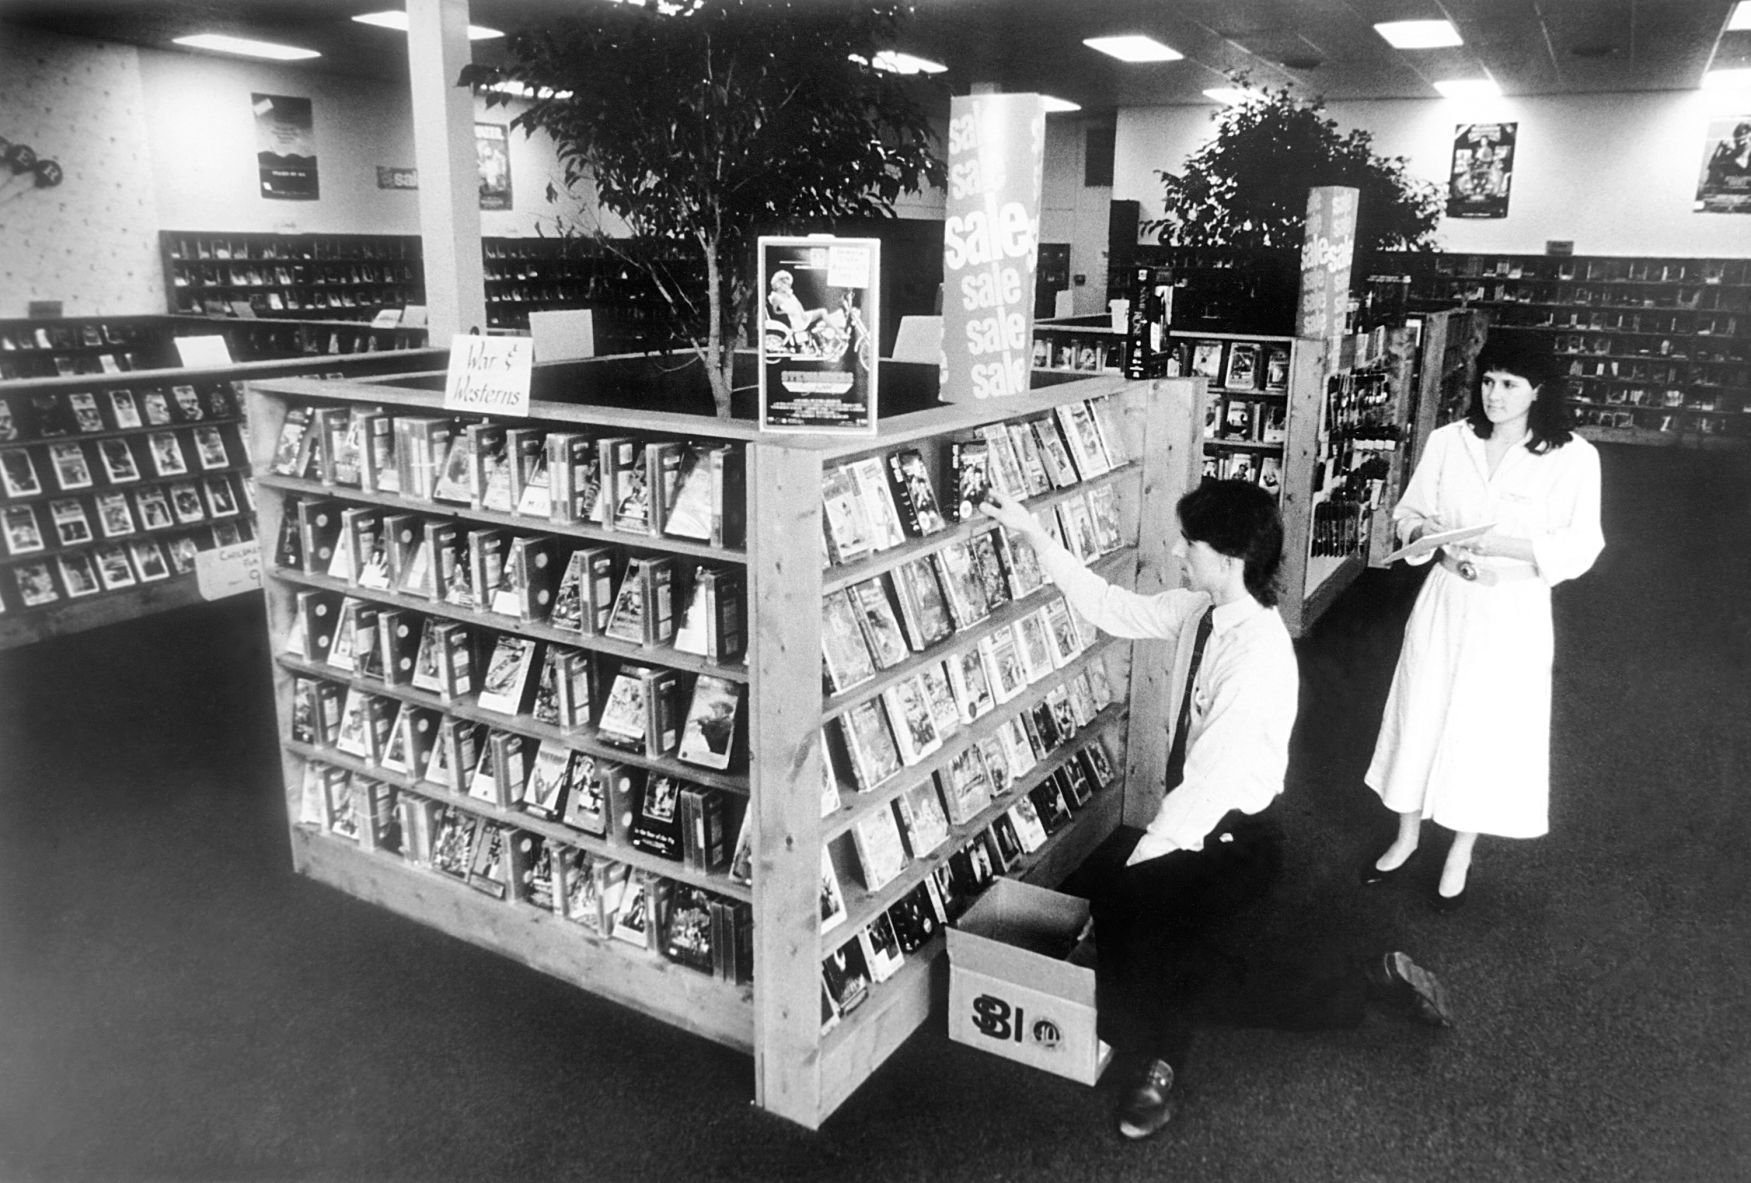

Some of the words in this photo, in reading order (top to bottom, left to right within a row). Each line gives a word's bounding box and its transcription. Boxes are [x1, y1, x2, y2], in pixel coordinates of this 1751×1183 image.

[394, 170, 417, 186] sal
[945, 202, 1029, 270] sale
[961, 261, 1021, 310] sale
[966, 304, 1026, 355] sale
[467, 341, 498, 370] War
[971, 350, 1025, 400] sale
[453, 375, 521, 406] Westerns
